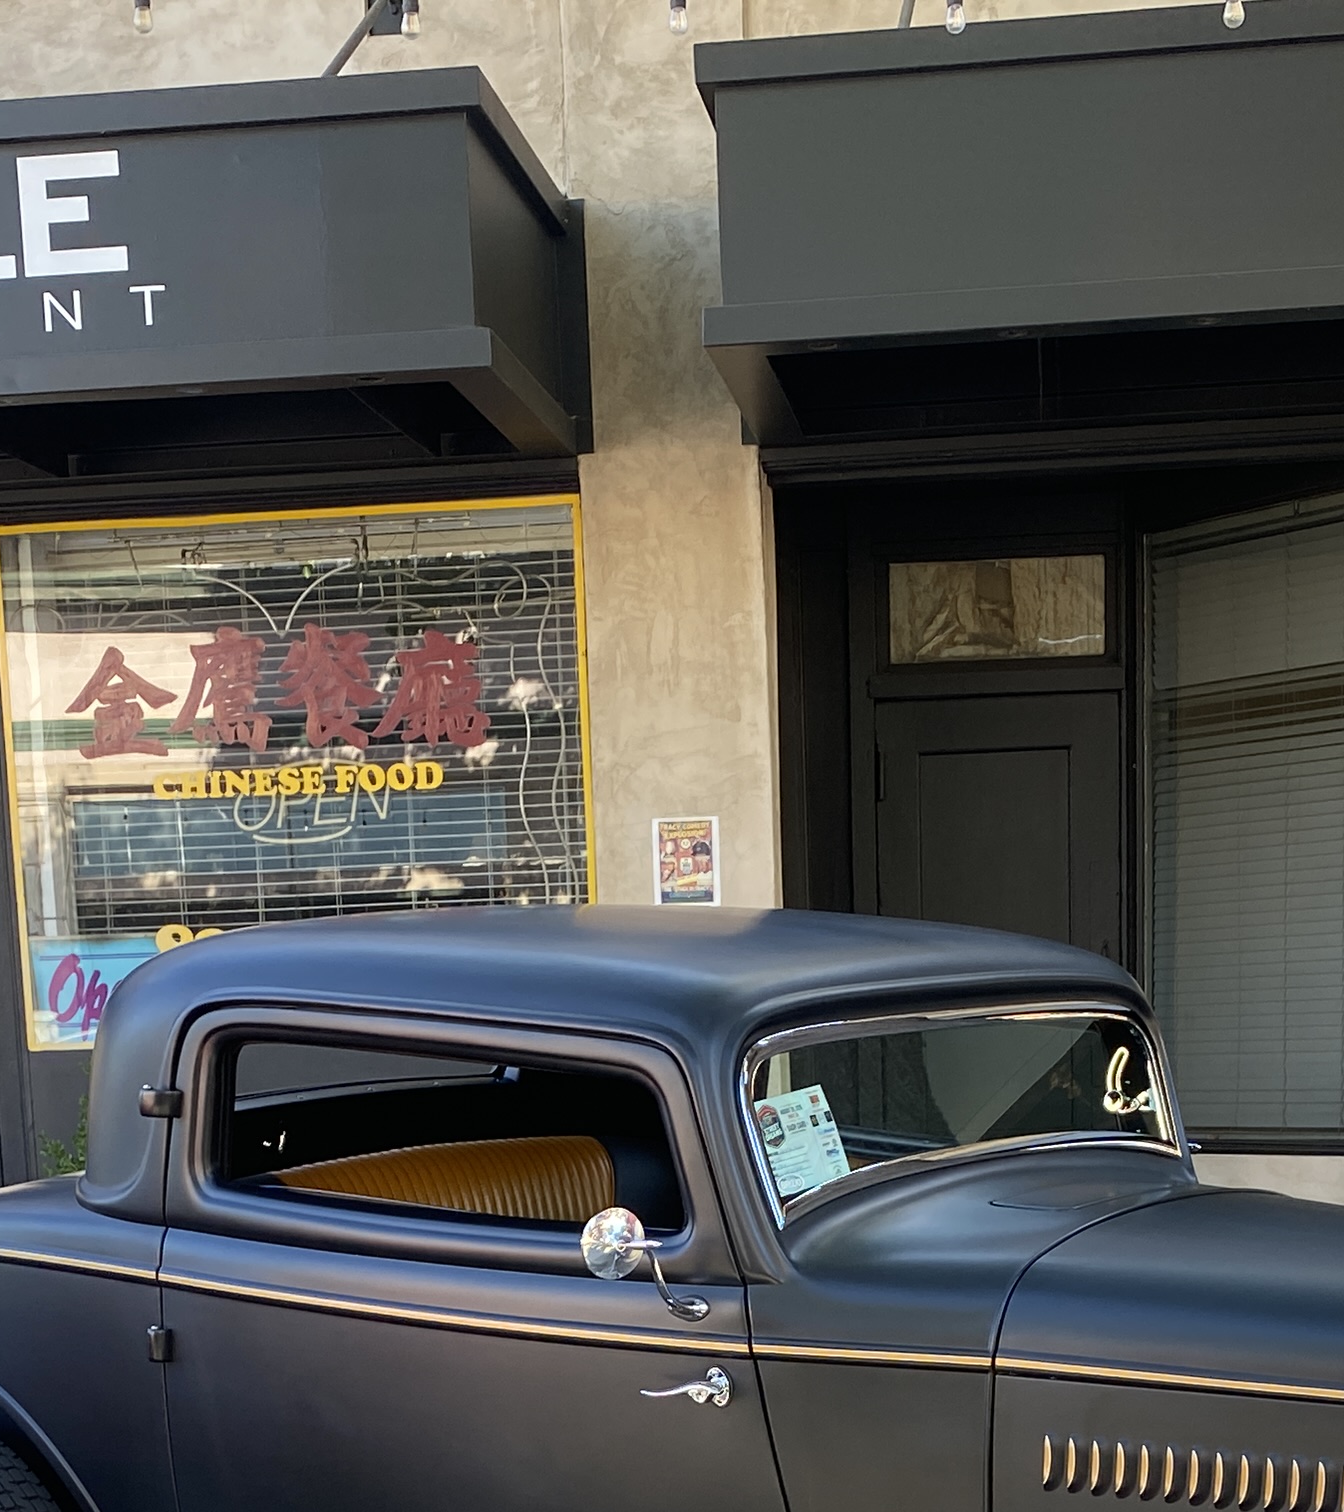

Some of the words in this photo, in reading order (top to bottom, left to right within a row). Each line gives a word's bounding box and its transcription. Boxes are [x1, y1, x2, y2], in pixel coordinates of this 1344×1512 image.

[64, 623, 492, 760] 金鷹餐廳
[153, 766, 326, 800] CHINESE
[335, 761, 445, 793] FOOD
